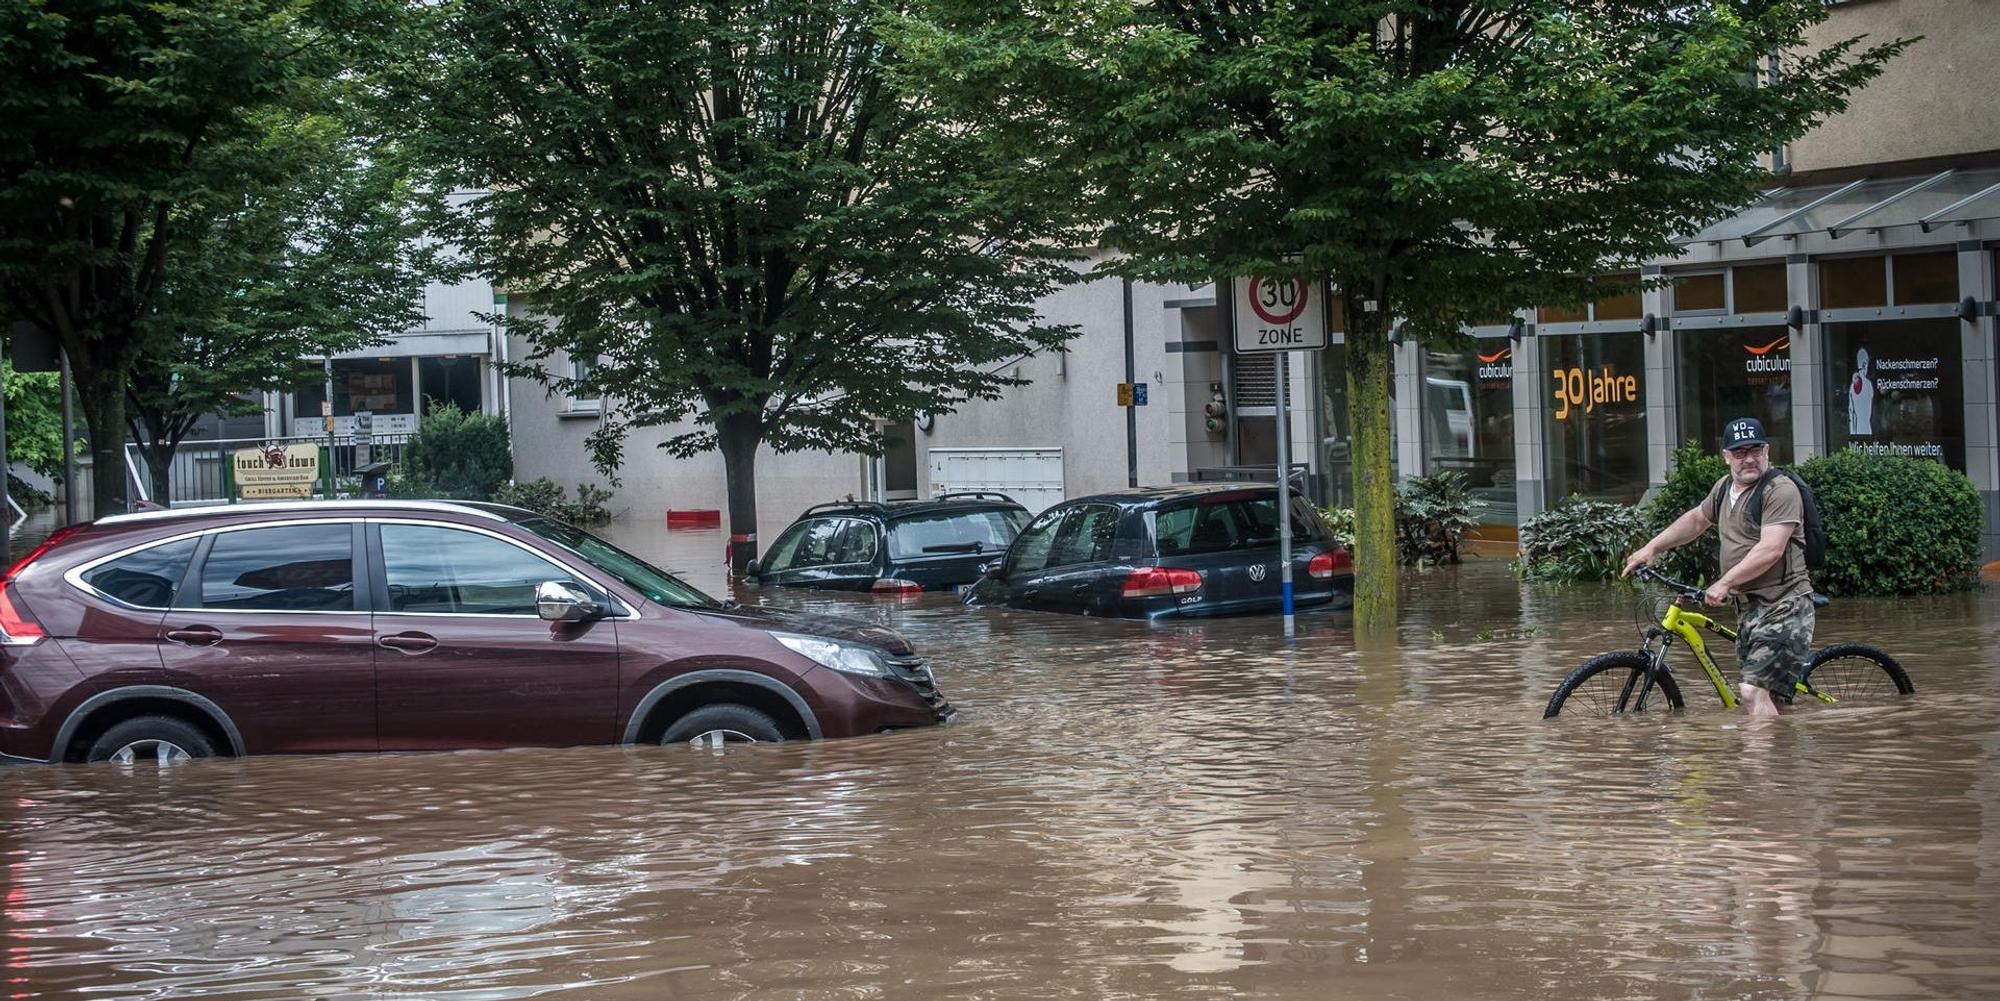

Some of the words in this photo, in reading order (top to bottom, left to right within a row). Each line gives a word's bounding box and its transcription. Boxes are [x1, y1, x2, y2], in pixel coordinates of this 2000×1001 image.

[1262, 279, 1295, 308] 30
[1258, 327, 1303, 344] ZONE
[1876, 358, 1938, 370] Nackenschmerzen?
[1876, 377, 1939, 390] Rückenschmerzen?
[1553, 367, 1585, 420] 30
[1586, 367, 1636, 413] Jahre
[1734, 430, 1755, 440] BLK
[1863, 441, 1889, 456] helfen
[237, 455, 265, 469] touch
[289, 454, 315, 468] down
[377, 478, 385, 490] P
[1181, 596, 1203, 605] GOLF
